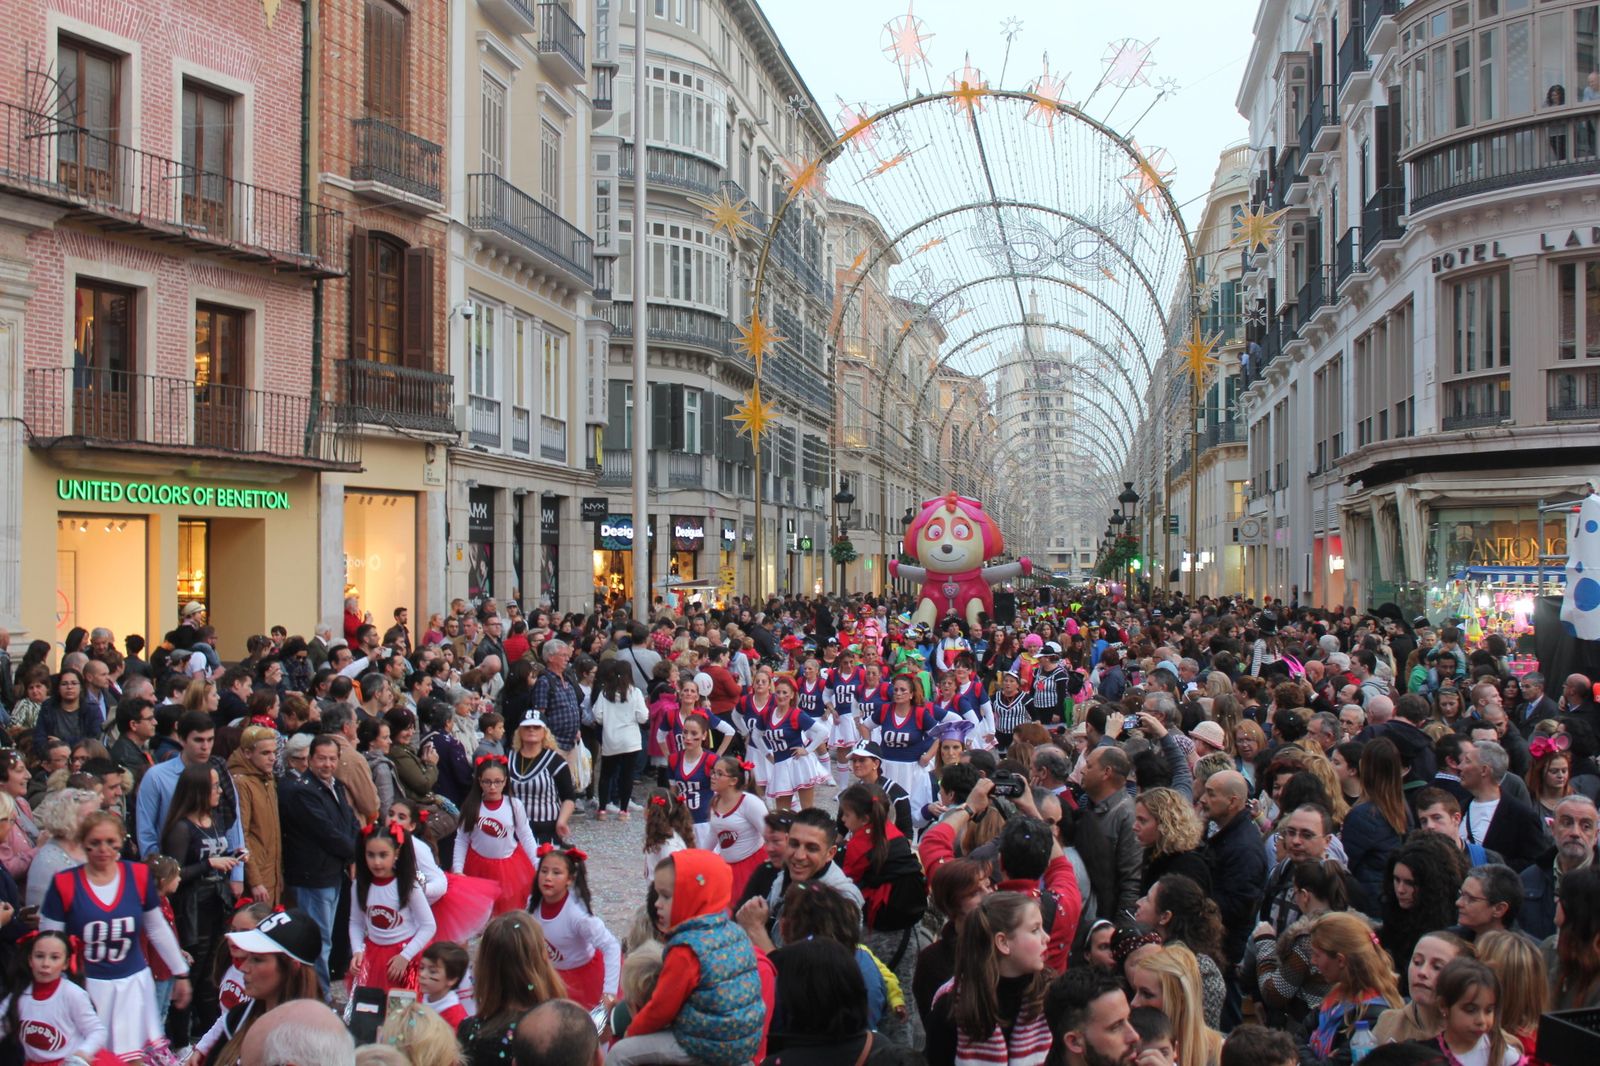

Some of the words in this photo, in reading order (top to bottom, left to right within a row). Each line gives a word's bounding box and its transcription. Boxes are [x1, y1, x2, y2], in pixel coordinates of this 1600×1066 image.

[1431, 241, 1506, 273] HOTEL
[58, 479, 123, 502] UNITED
[125, 483, 190, 506] COLORS
[192, 487, 214, 506] OF
[584, 503, 605, 511] NYX
[836, 685, 855, 704] 85
[765, 729, 788, 752] 85
[884, 730, 910, 748] 85
[83, 916, 135, 963] 85
[25, 1024, 56, 1044] RUGBY
